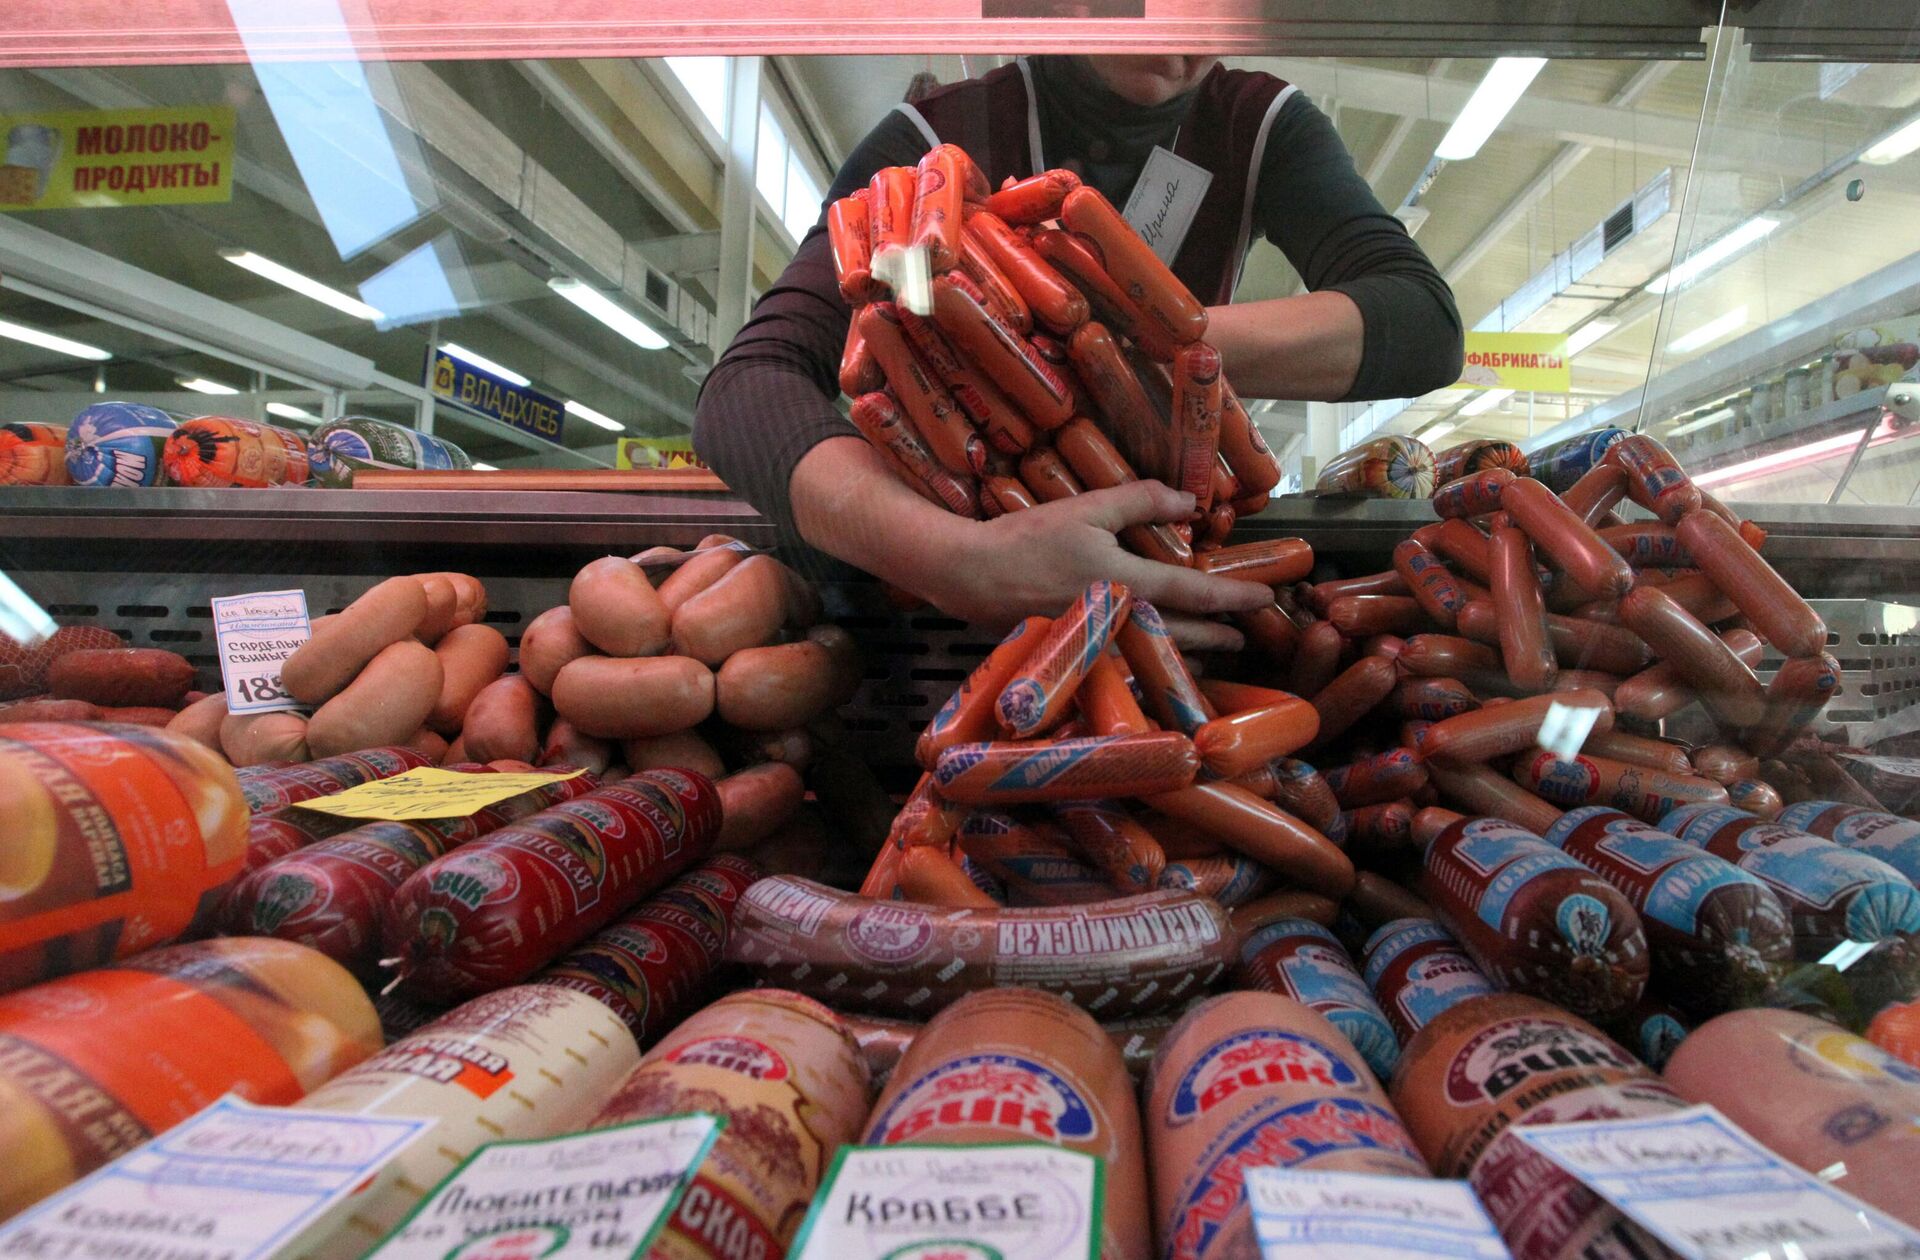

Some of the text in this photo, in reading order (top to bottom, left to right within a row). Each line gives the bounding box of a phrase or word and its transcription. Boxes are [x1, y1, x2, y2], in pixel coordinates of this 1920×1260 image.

[76, 122, 221, 155] МОЛОКО-
[74, 162, 220, 193] ПРОДУКТЫ
[1464, 351, 1563, 369] ФАБРИКАТЫ
[460, 372, 561, 436] ВЛАДХЛЕБ
[229, 651, 290, 664] СВИНЫЕ
[432, 870, 489, 909] ВИК
[1199, 1062, 1337, 1113] ВИК
[1484, 1048, 1626, 1099] ВИК
[885, 1096, 1057, 1144] ВИК
[845, 1190, 1041, 1225] КРАББЕ
